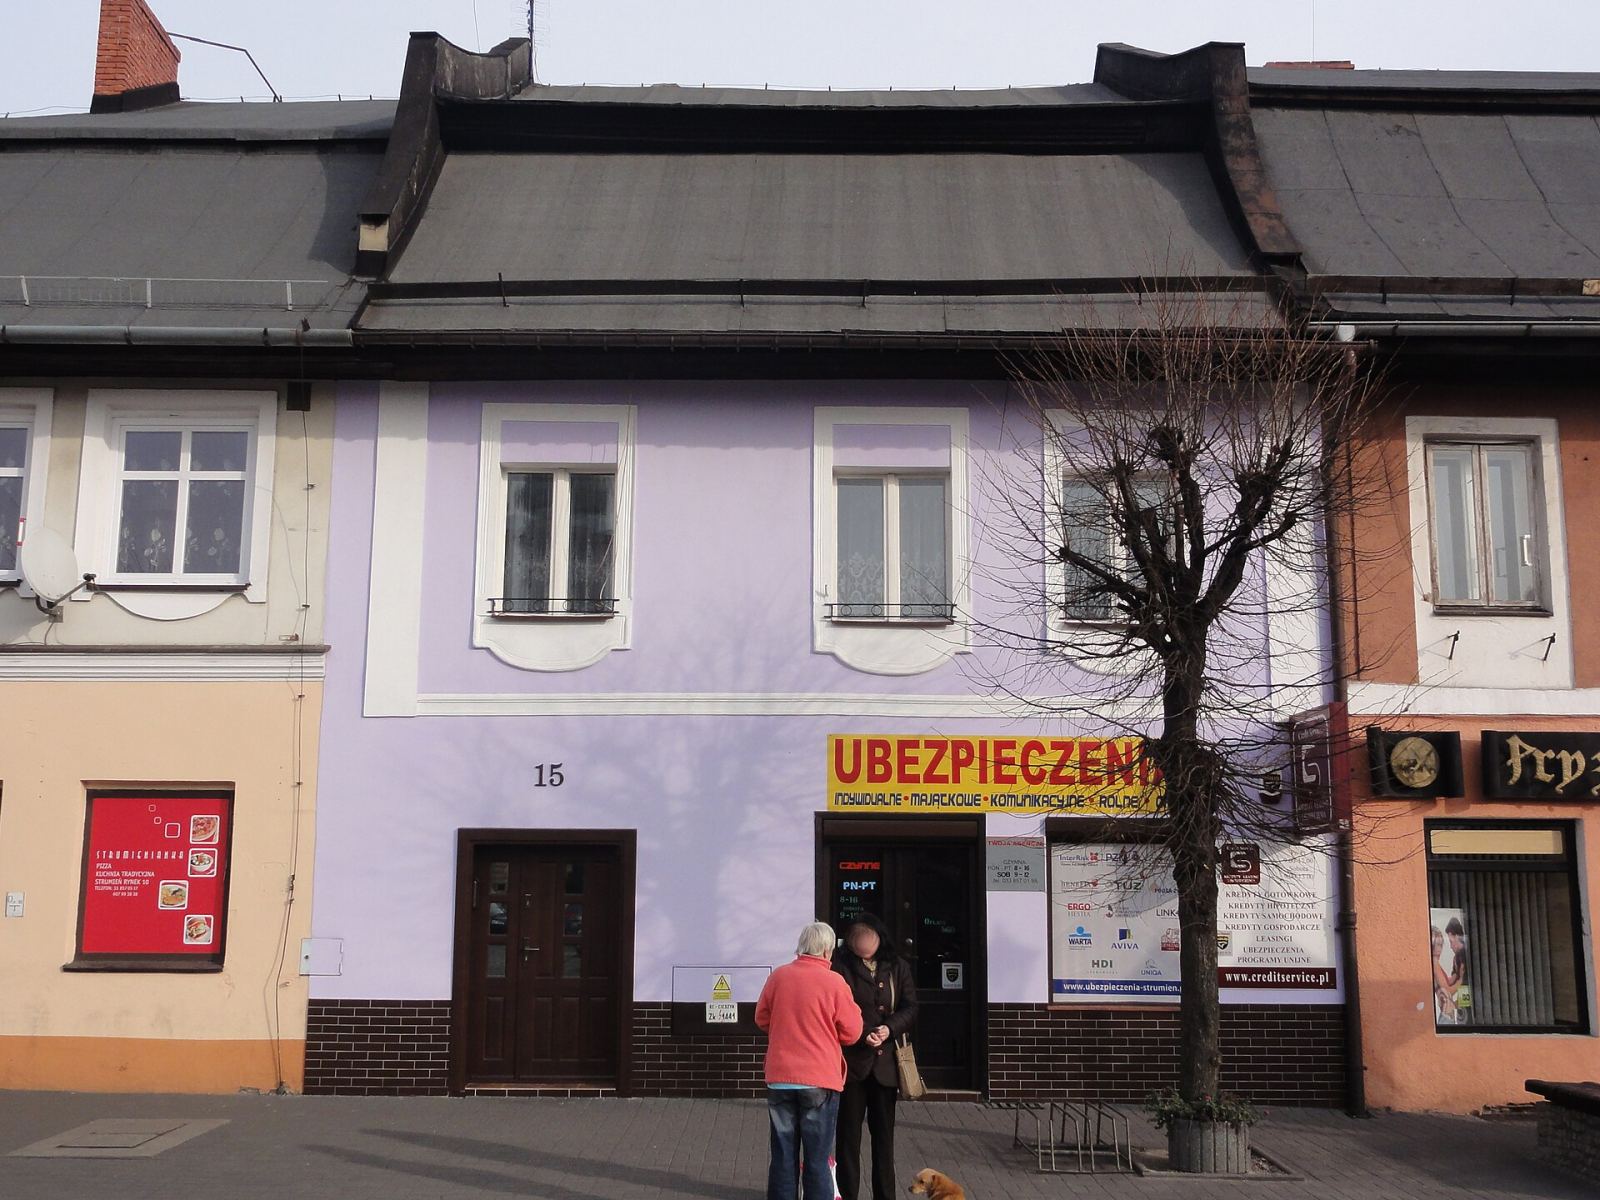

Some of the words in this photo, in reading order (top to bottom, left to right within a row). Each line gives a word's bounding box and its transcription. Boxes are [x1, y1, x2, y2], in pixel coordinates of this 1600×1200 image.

[834, 738, 1164, 787] UBEZPIECZENI
[534, 763, 564, 787] 15
[843, 881, 876, 890] PN-PT
[1256, 935, 1293, 943] LEASINGI
[1243, 946, 1305, 954] UBEZPIECZENIA
[1092, 959, 1113, 968] HDI
[1237, 956, 1281, 964] PROGRAMY
[1284, 956, 1312, 964] UNIJNE
[1225, 971, 1329, 986] www.creditservice.pl
